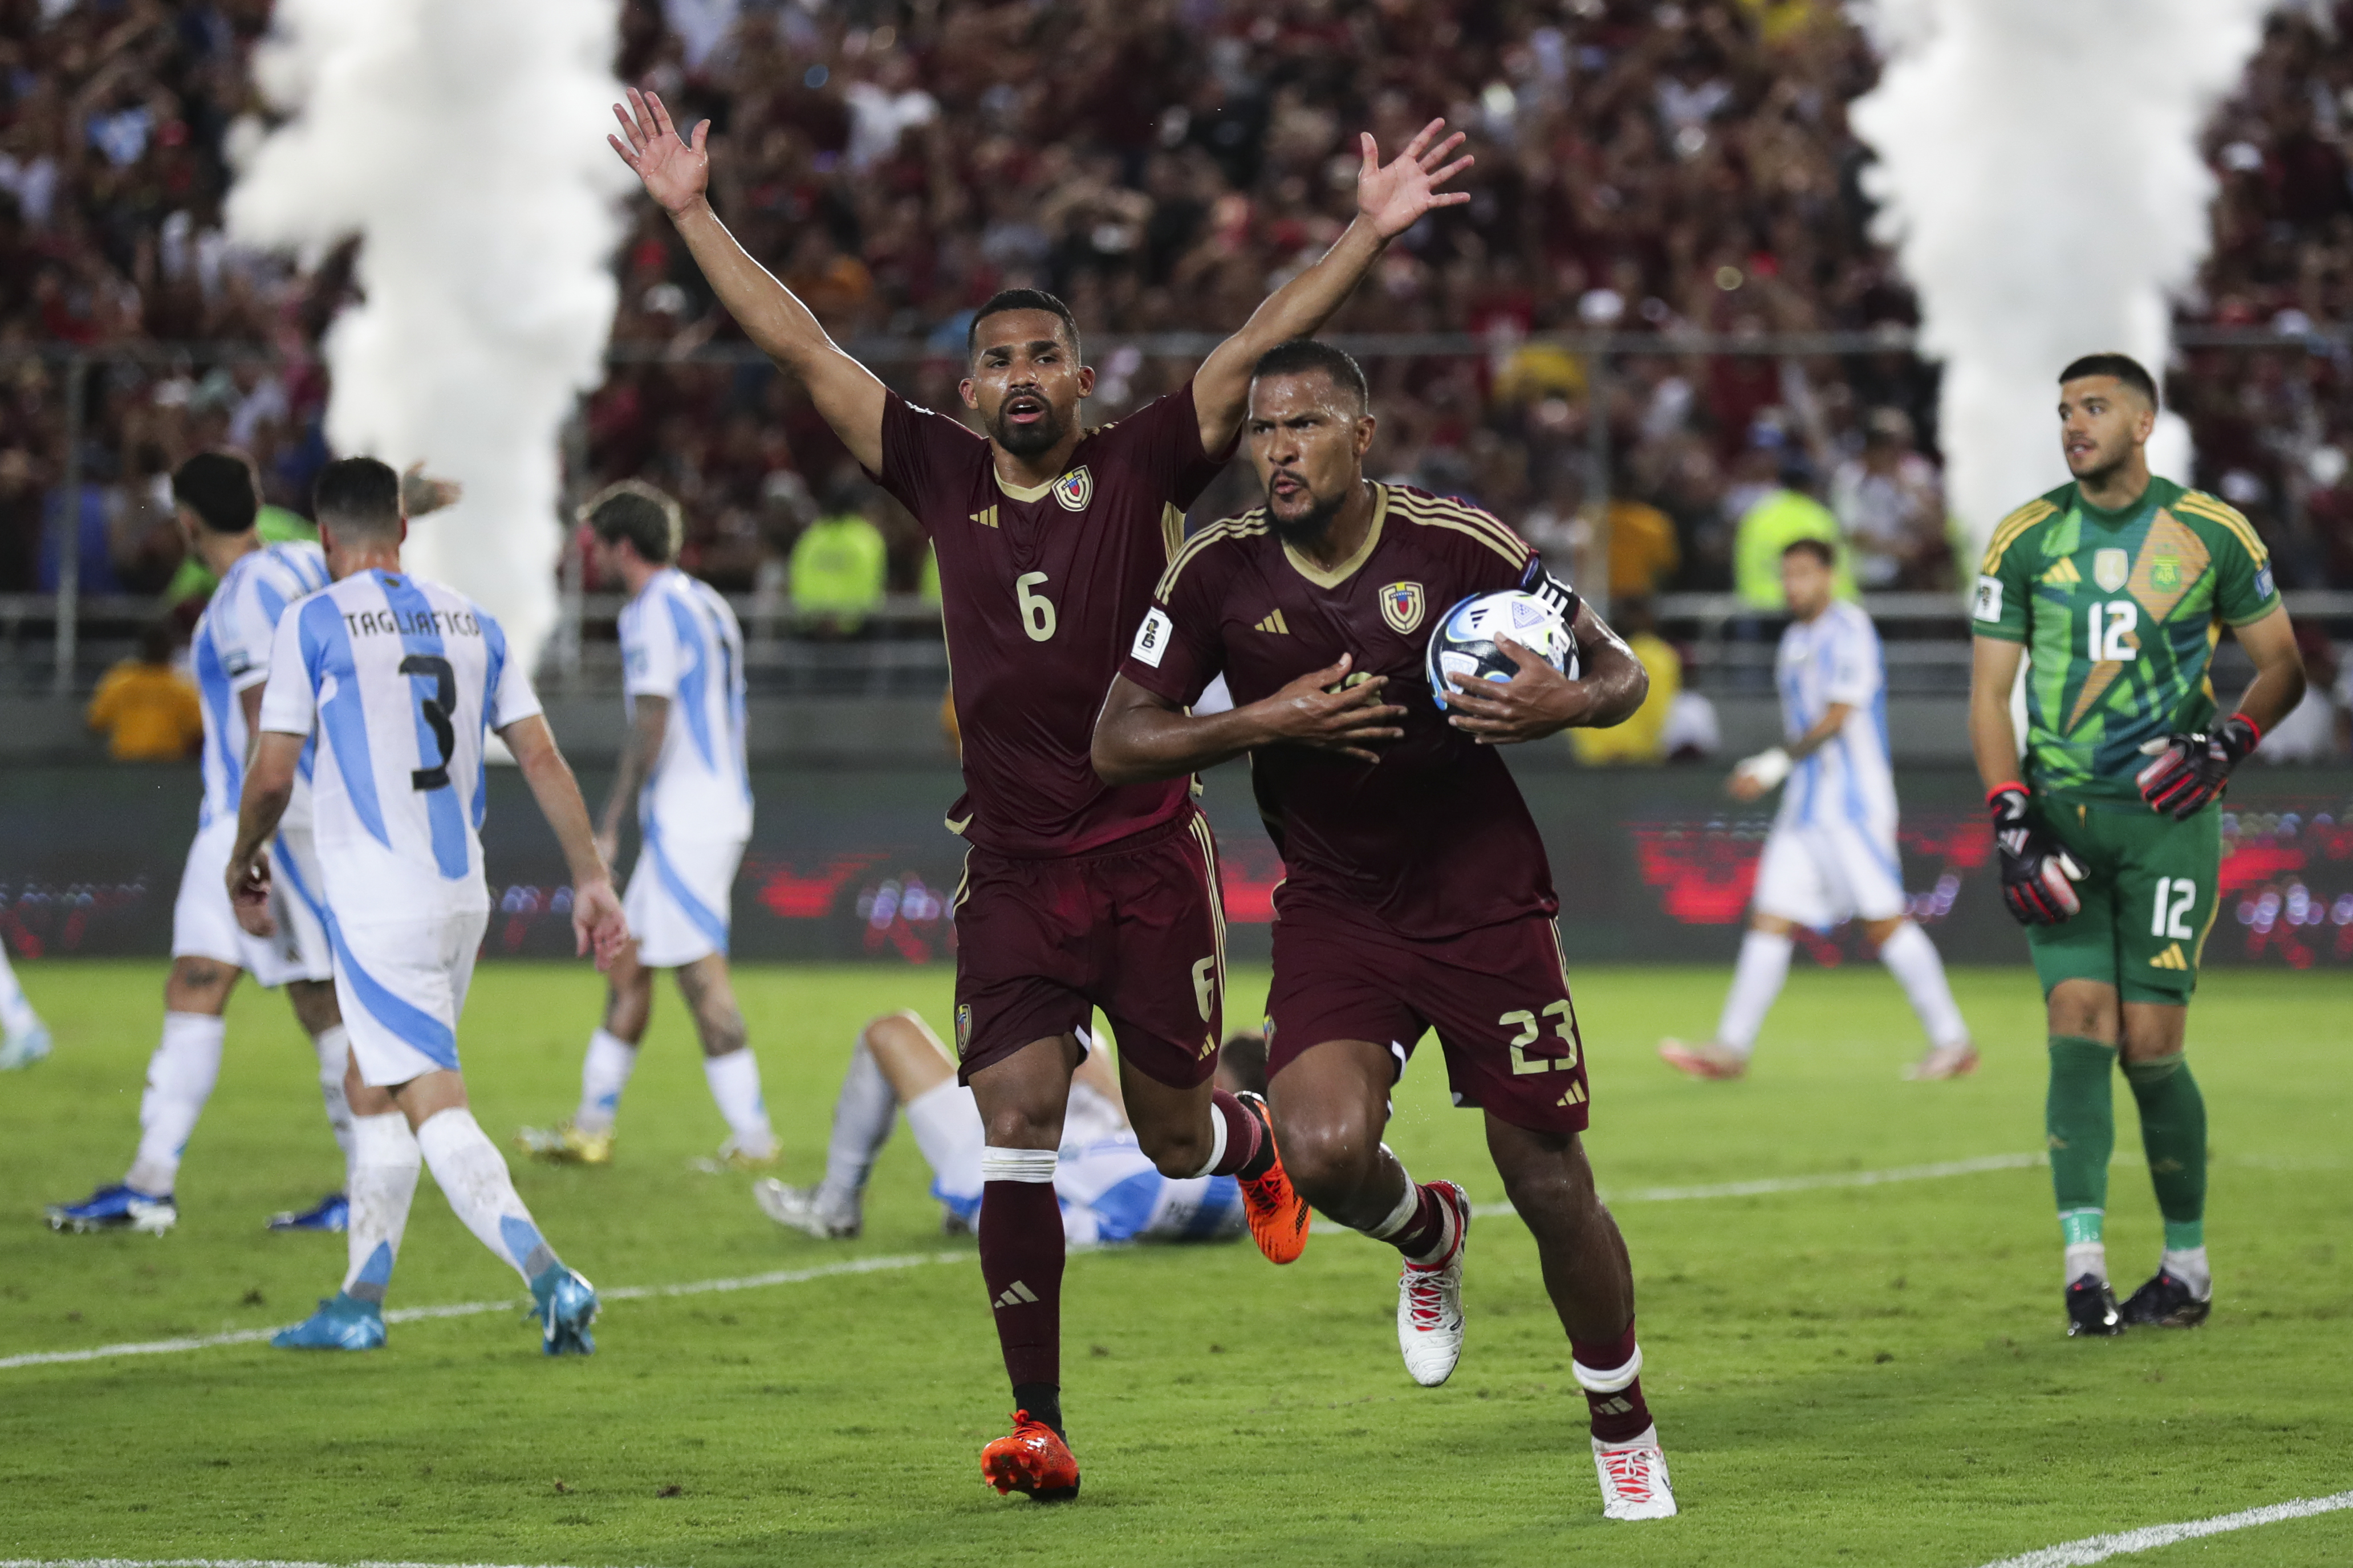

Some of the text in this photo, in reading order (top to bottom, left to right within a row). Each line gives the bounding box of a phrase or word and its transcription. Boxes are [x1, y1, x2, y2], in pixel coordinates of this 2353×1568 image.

[343, 610, 479, 638] TAGLIAFICO
[1017, 572, 1056, 642] 6
[2088, 600, 2137, 661] 12
[399, 654, 456, 790] 3
[2151, 876, 2196, 940] 12
[1192, 955, 1214, 1023] 6
[1499, 999, 1578, 1075] 23
